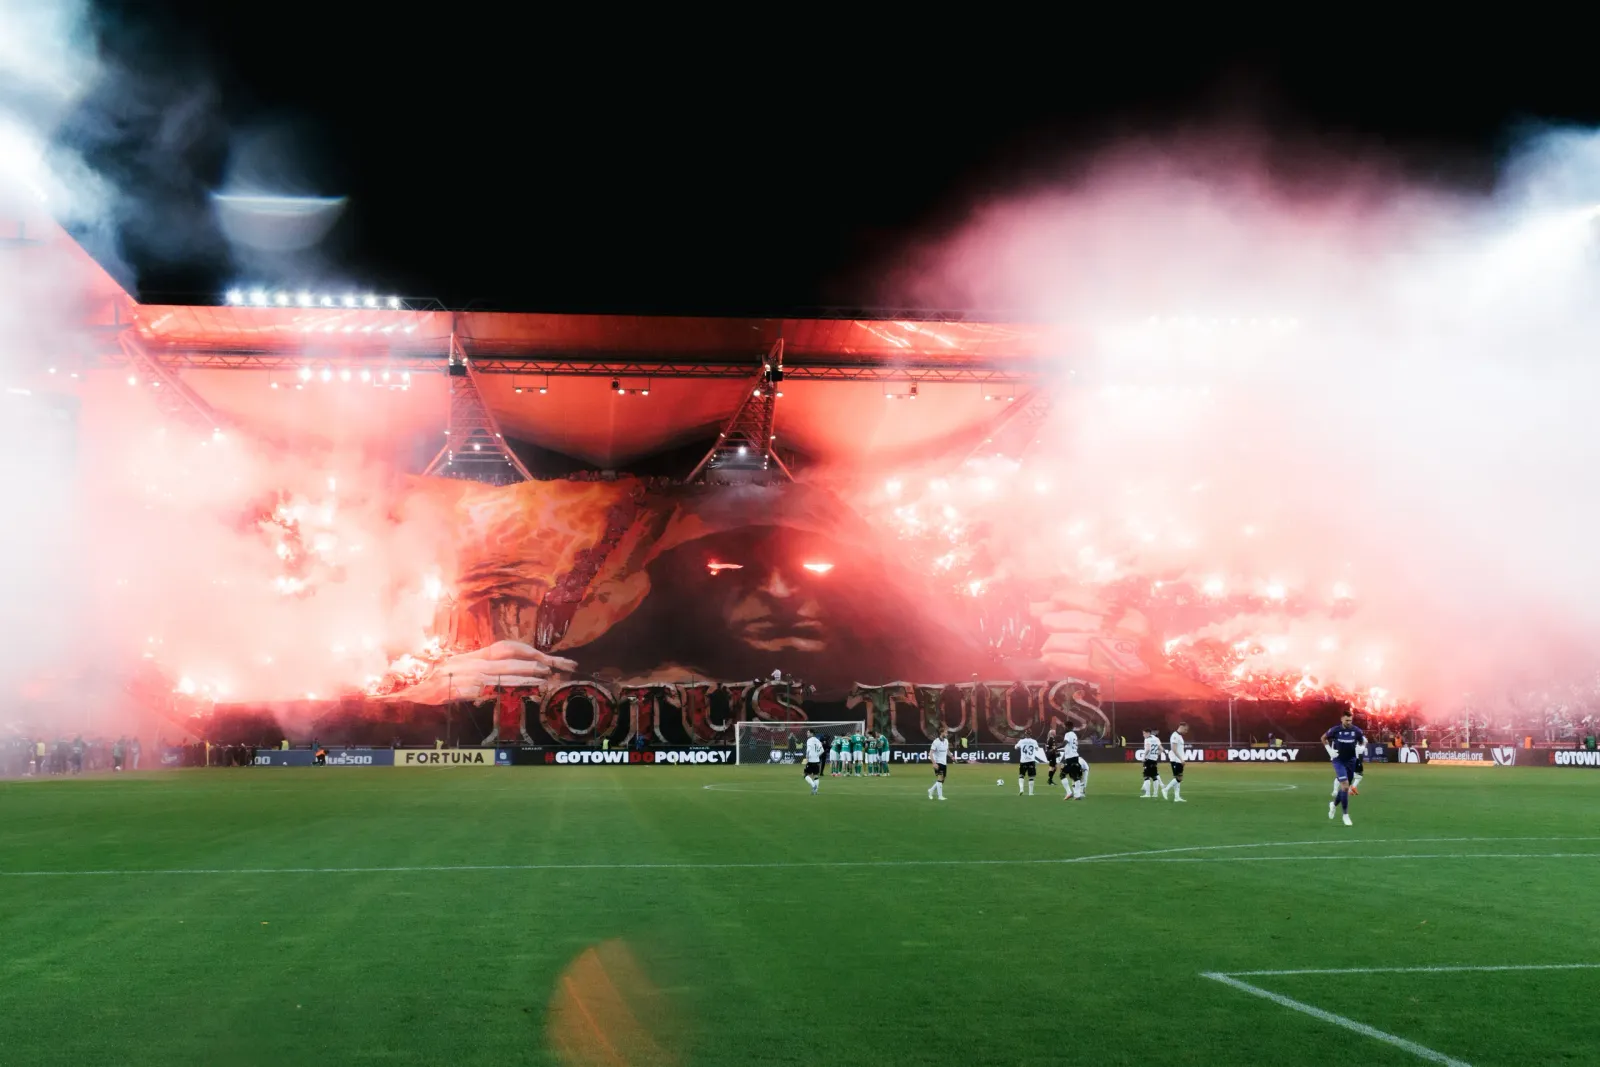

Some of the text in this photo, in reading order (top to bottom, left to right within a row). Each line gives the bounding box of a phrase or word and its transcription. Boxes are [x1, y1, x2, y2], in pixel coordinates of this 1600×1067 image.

[480, 677, 1111, 746] TOTUS TUUS
[1022, 744, 1034, 756] 43
[315, 753, 373, 765] lus500
[405, 752, 485, 764] FORTUNA
